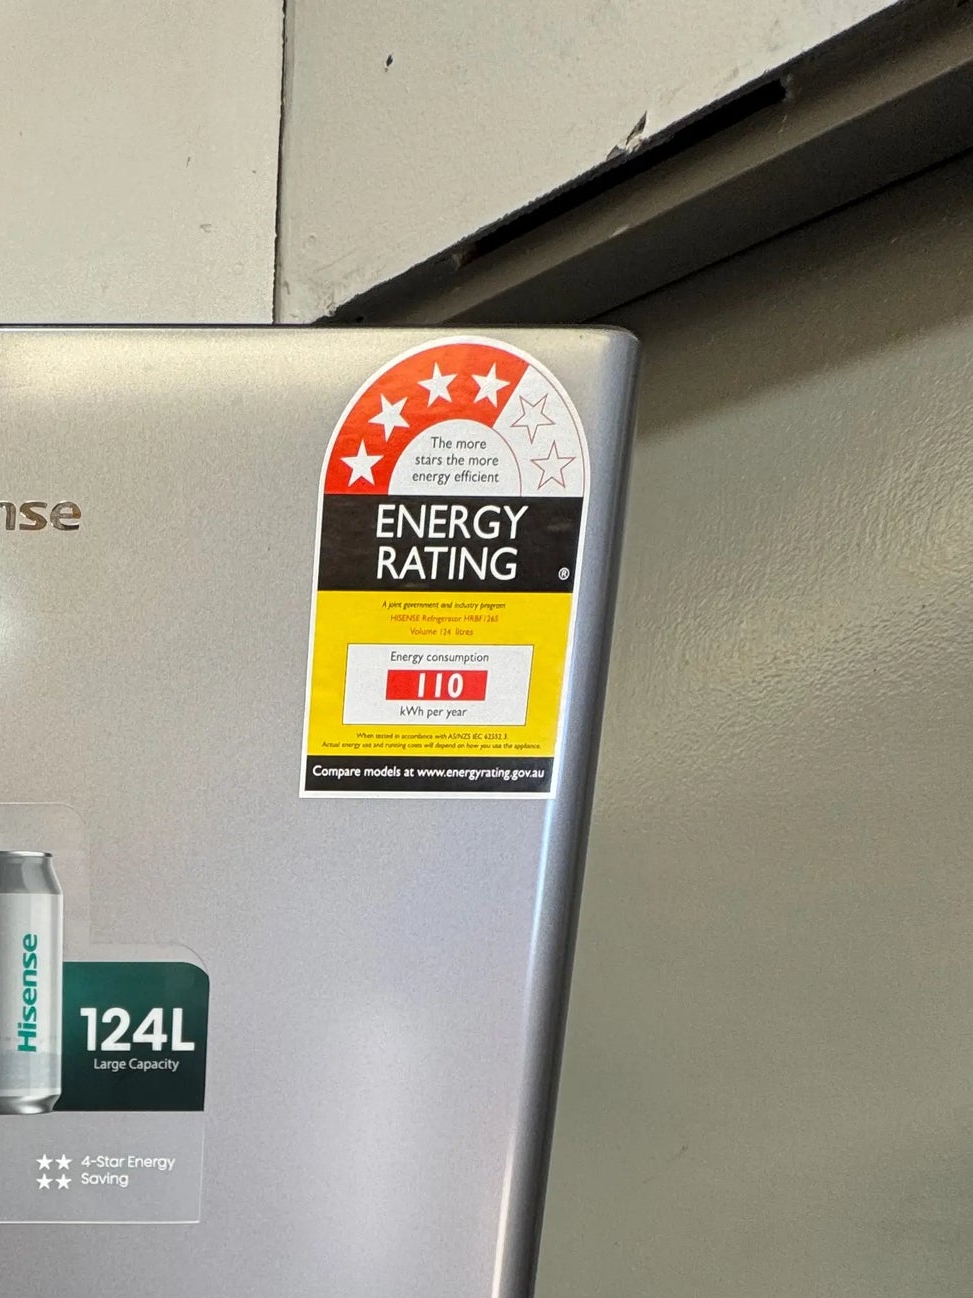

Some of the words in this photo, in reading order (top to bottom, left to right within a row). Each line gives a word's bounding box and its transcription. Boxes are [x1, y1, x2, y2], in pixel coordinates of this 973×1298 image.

[431, 437, 453, 449] The
[456, 439, 486, 450] more
[415, 455, 443, 466] stars
[446, 455, 465, 466] the
[468, 457, 499, 467] more
[412, 473, 450, 485] energy
[454, 470, 499, 483] efficient
[377, 504, 529, 539] ENERGY
[377, 546, 518, 581] RATING
[388, 601, 402, 610] joint
[403, 602, 439, 610] government
[454, 602, 478, 610] industry
[479, 603, 506, 611] program
[390, 614, 420, 623] HISENSE
[422, 614, 461, 624] Refrigerator
[410, 627, 437, 636] Volume
[439, 627, 451, 636] 124
[455, 627, 474, 636] litres
[390, 651, 424, 664] Energy
[427, 653, 489, 665] consumption
[417, 672, 464, 699] 110
[400, 705, 424, 717] kWh
[427, 708, 444, 719] per
[446, 708, 467, 719] year
[342, 742, 361, 750] energy
[385, 742, 406, 750] running
[435, 742, 456, 750] depend
[312, 765, 361, 780] Compare
[364, 766, 401, 777] models
[404, 768, 414, 777] at
[417, 767, 545, 781] www.energyrating.gov.au
[17, 933, 38, 1053] Hisense
[80, 1007, 195, 1051] 124L
[93, 1057, 127, 1073] Large
[128, 1057, 180, 1074] Capacity
[81, 1155, 126, 1169] 4-Star
[127, 1155, 176, 1172] Energy
[81, 1172, 129, 1188] Saving
